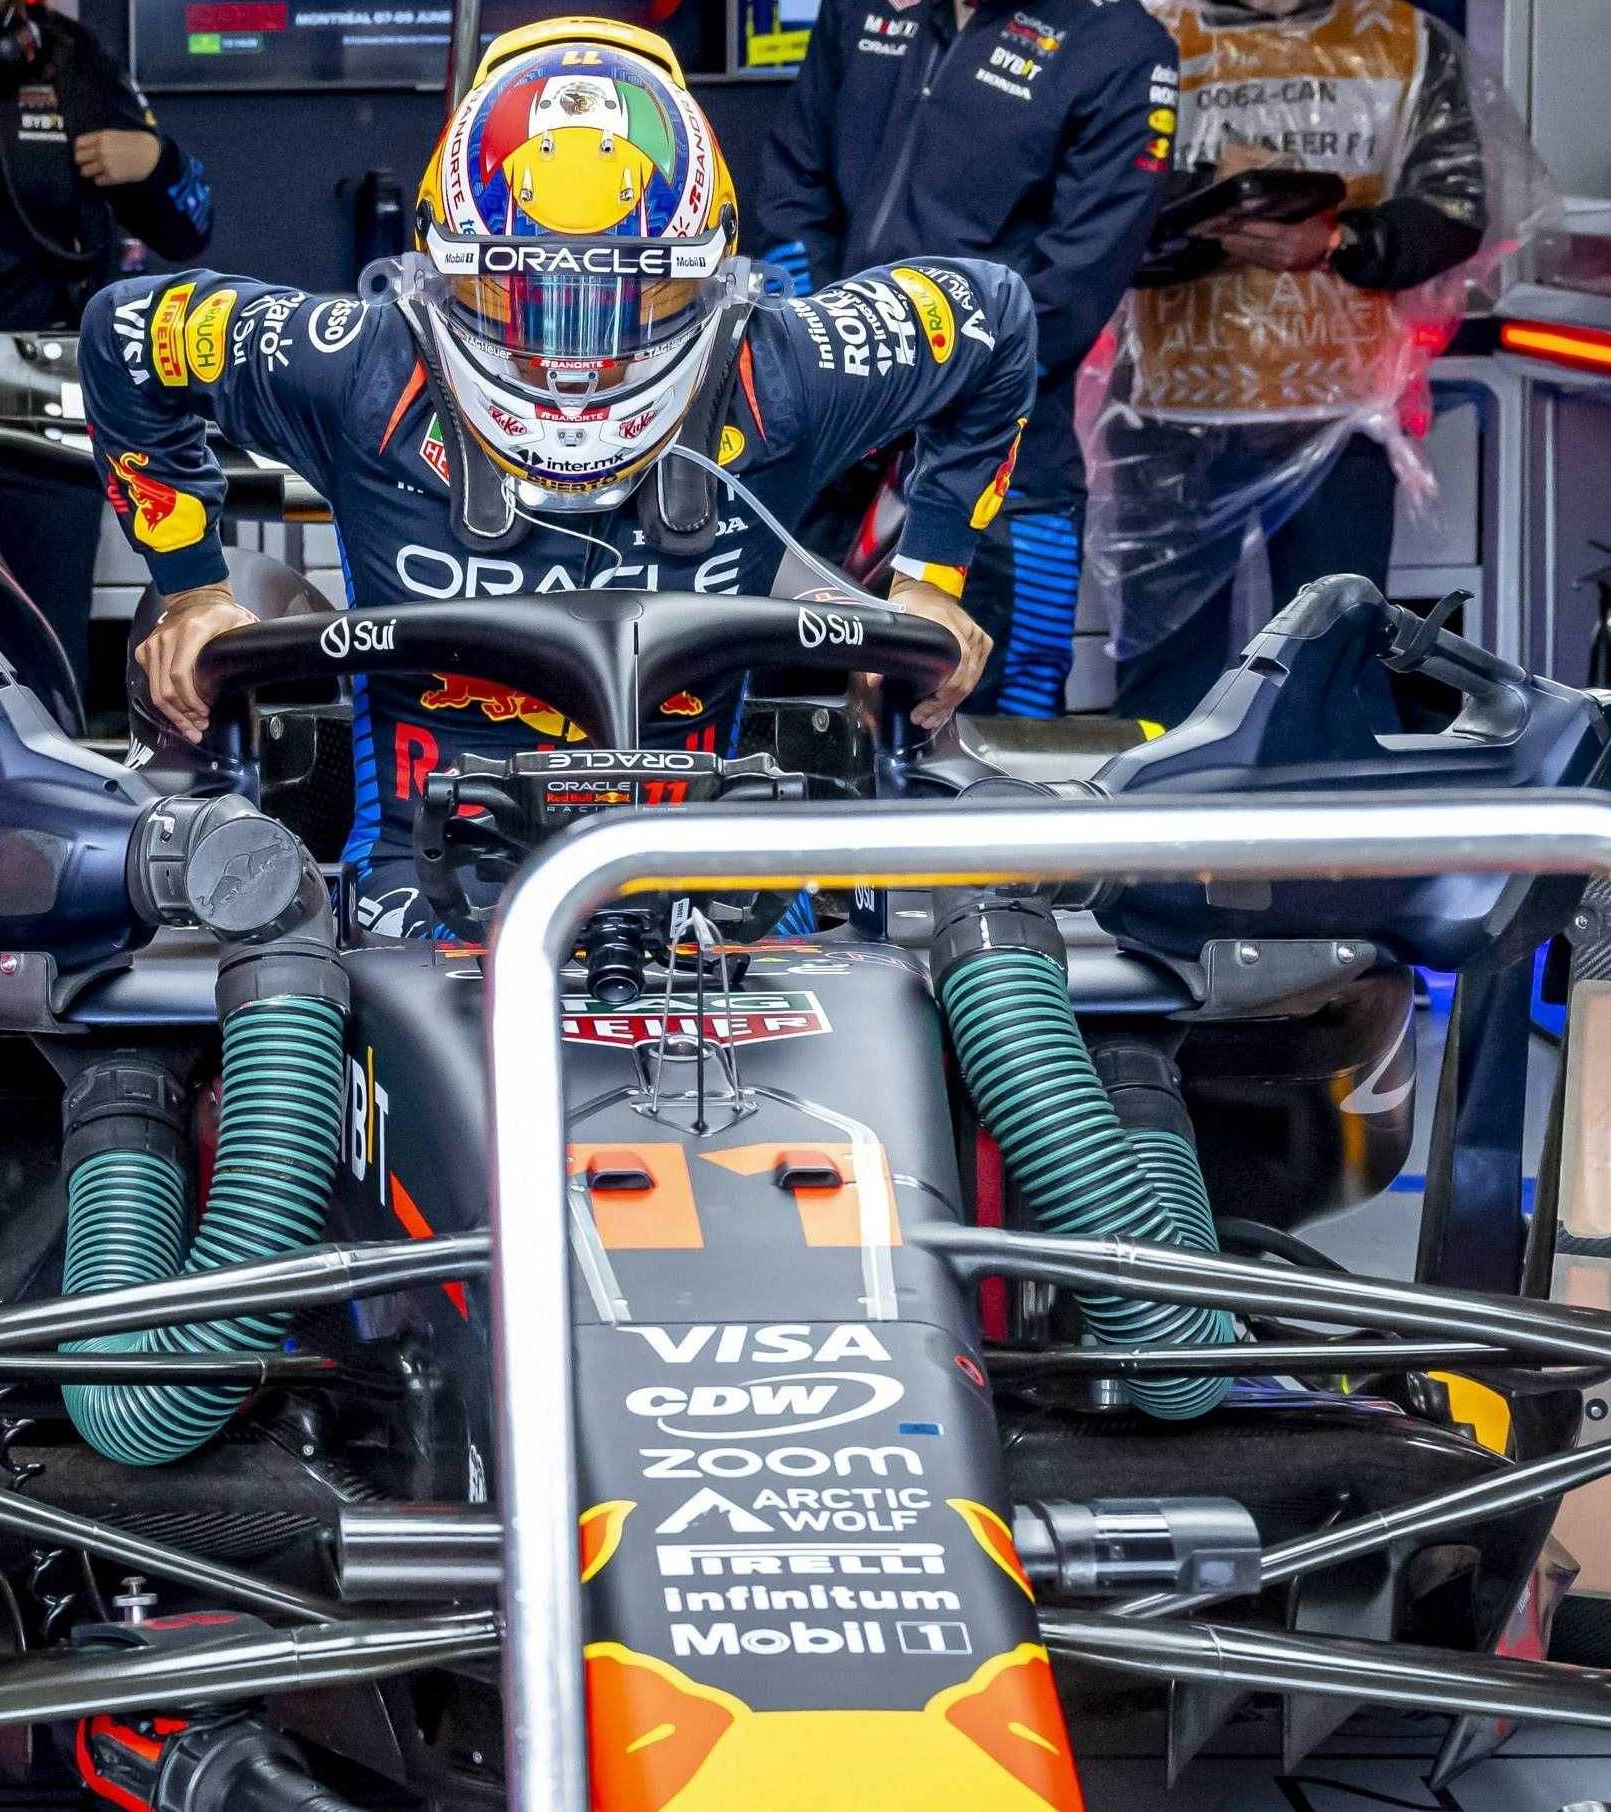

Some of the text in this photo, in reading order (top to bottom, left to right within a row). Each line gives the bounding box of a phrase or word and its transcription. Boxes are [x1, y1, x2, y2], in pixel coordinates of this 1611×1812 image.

[484, 247, 665, 274] ORACLE
[156, 291, 190, 378] PIRELLI
[547, 453, 624, 472] inter.mx
[354, 619, 394, 650] Sui
[829, 615, 863, 645] Sui
[548, 753, 694, 769] ORACLE
[547, 781, 631, 791] ORACLE
[642, 780, 688, 807] 11
[615, 1324, 892, 1363] VISA
[625, 1385, 839, 1416] CDW
[639, 1446, 924, 1478] zoom
[752, 1488, 932, 1509] ARCTIC
[778, 1511, 918, 1531] WOLF
[656, 1543, 946, 1576] PIRELLI
[663, 1585, 961, 1612] infinitum
[670, 1621, 886, 1656] Mobil
